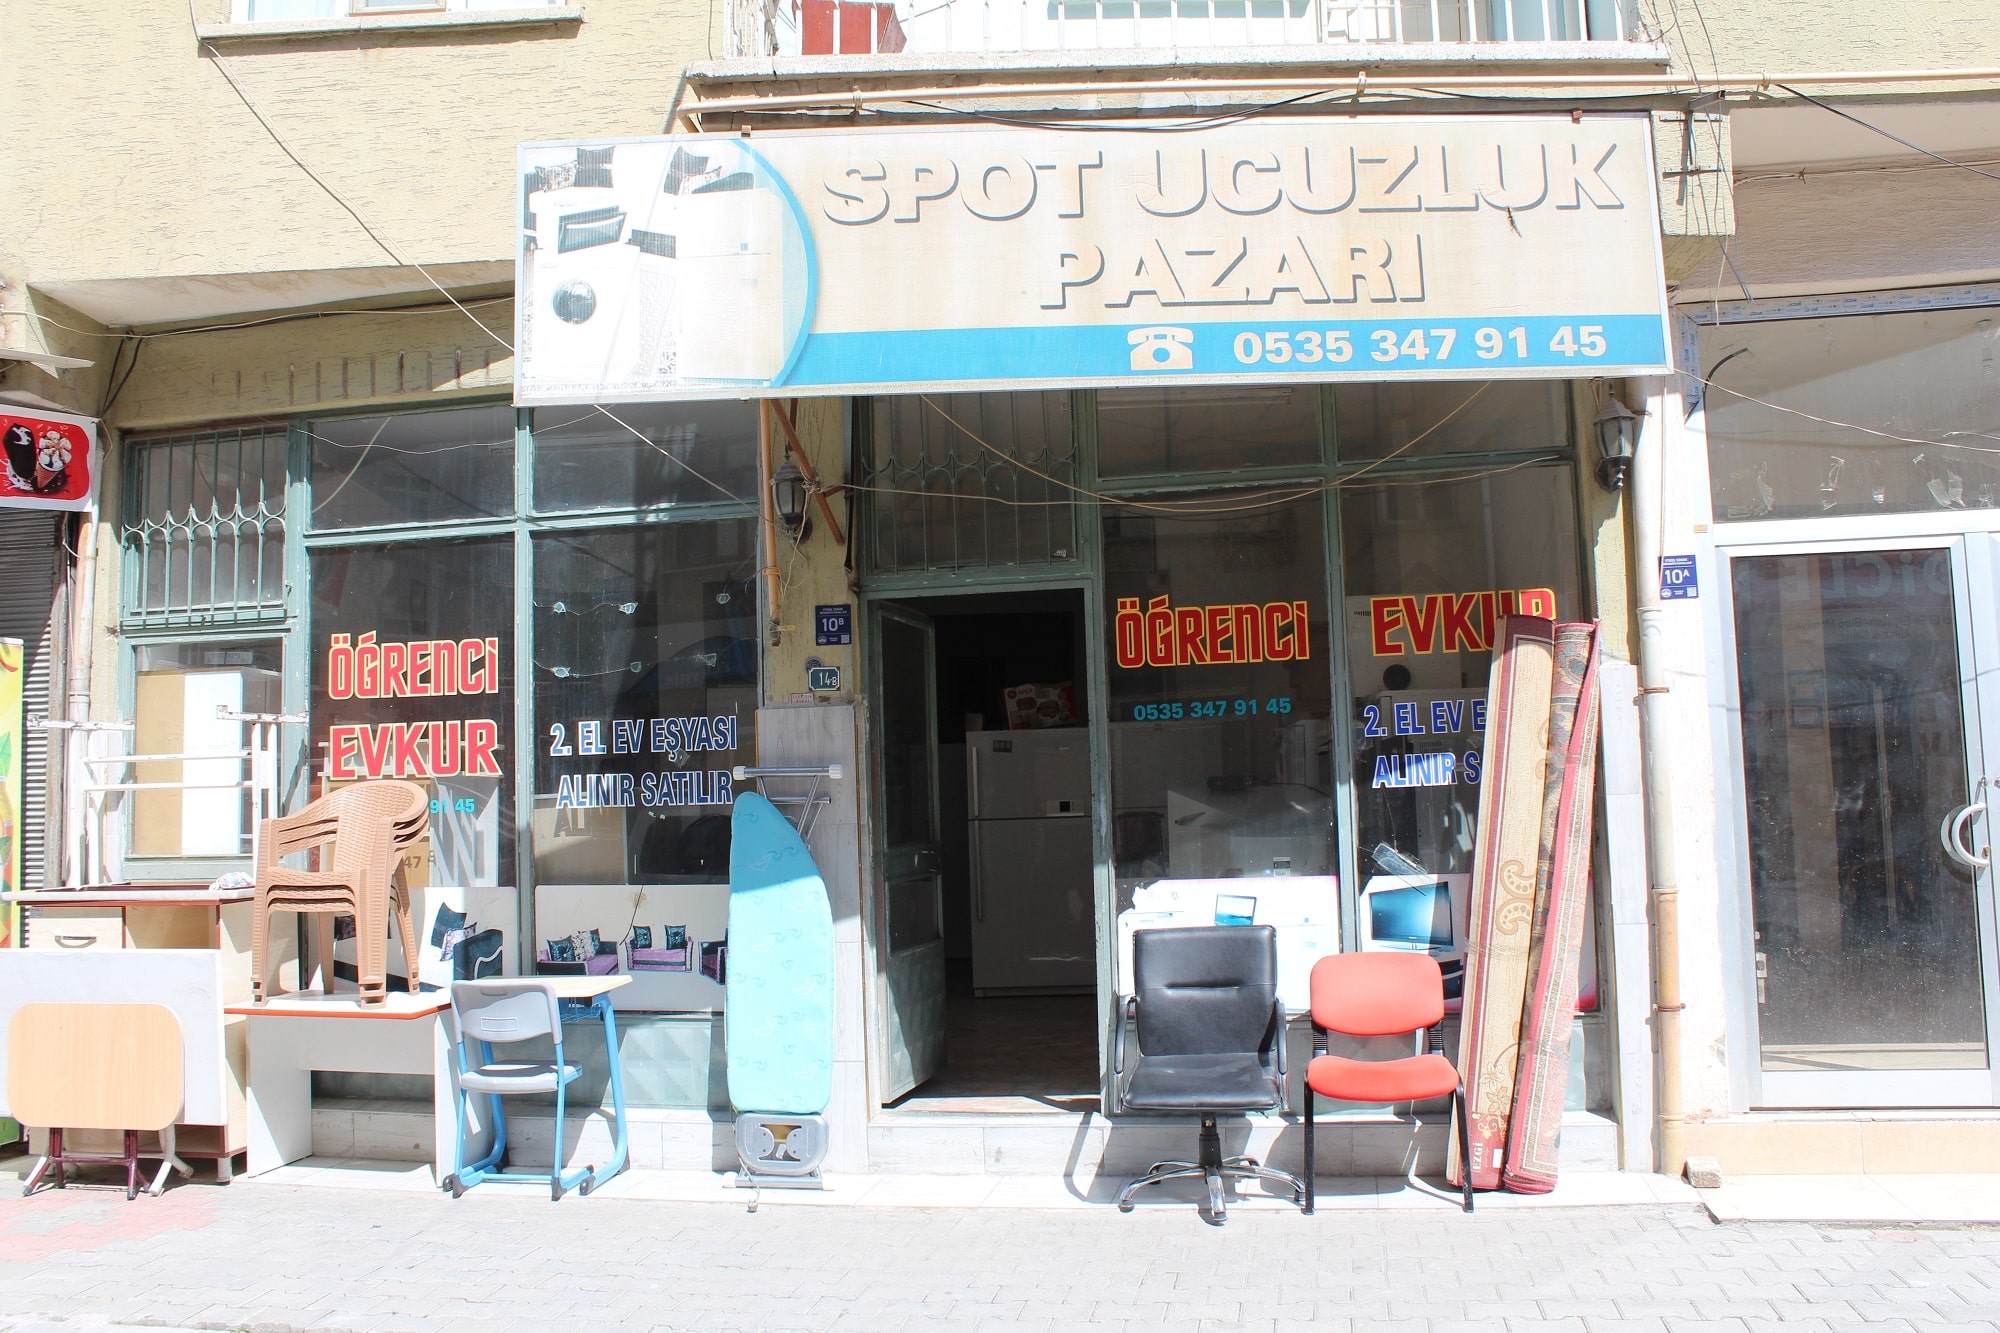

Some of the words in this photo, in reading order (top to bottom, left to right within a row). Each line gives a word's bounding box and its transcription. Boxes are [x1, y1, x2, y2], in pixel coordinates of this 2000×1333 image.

[822, 149, 1104, 226] SPOT
[1135, 142, 1625, 218] UCUZLUK
[1038, 233, 1426, 311] PAZARI
[1233, 330, 1354, 364] 0535
[1369, 328, 1457, 361] 347
[1474, 326, 1529, 360] 91
[1549, 325, 1608, 357] 45
[1133, 702, 1184, 721] 0535
[1190, 700, 1228, 718] 347
[1234, 699, 1258, 716] 91
[1265, 697, 1292, 714] 45
[1363, 704, 1388, 738] 2.
[1394, 701, 1426, 736] EL
[1430, 700, 1465, 734] EV
[329, 718, 504, 781] EVKUR
[550, 722, 573, 757] 2.
[578, 720, 608, 756] EL
[612, 719, 645, 754] EV
[650, 715, 737, 762] EŞYASI
[556, 773, 636, 809] ALINIR
[640, 770, 734, 807] SATILIR
[1371, 752, 1458, 789] ALINIR
[429, 799, 448, 814] 91
[455, 798, 475, 813] 45
